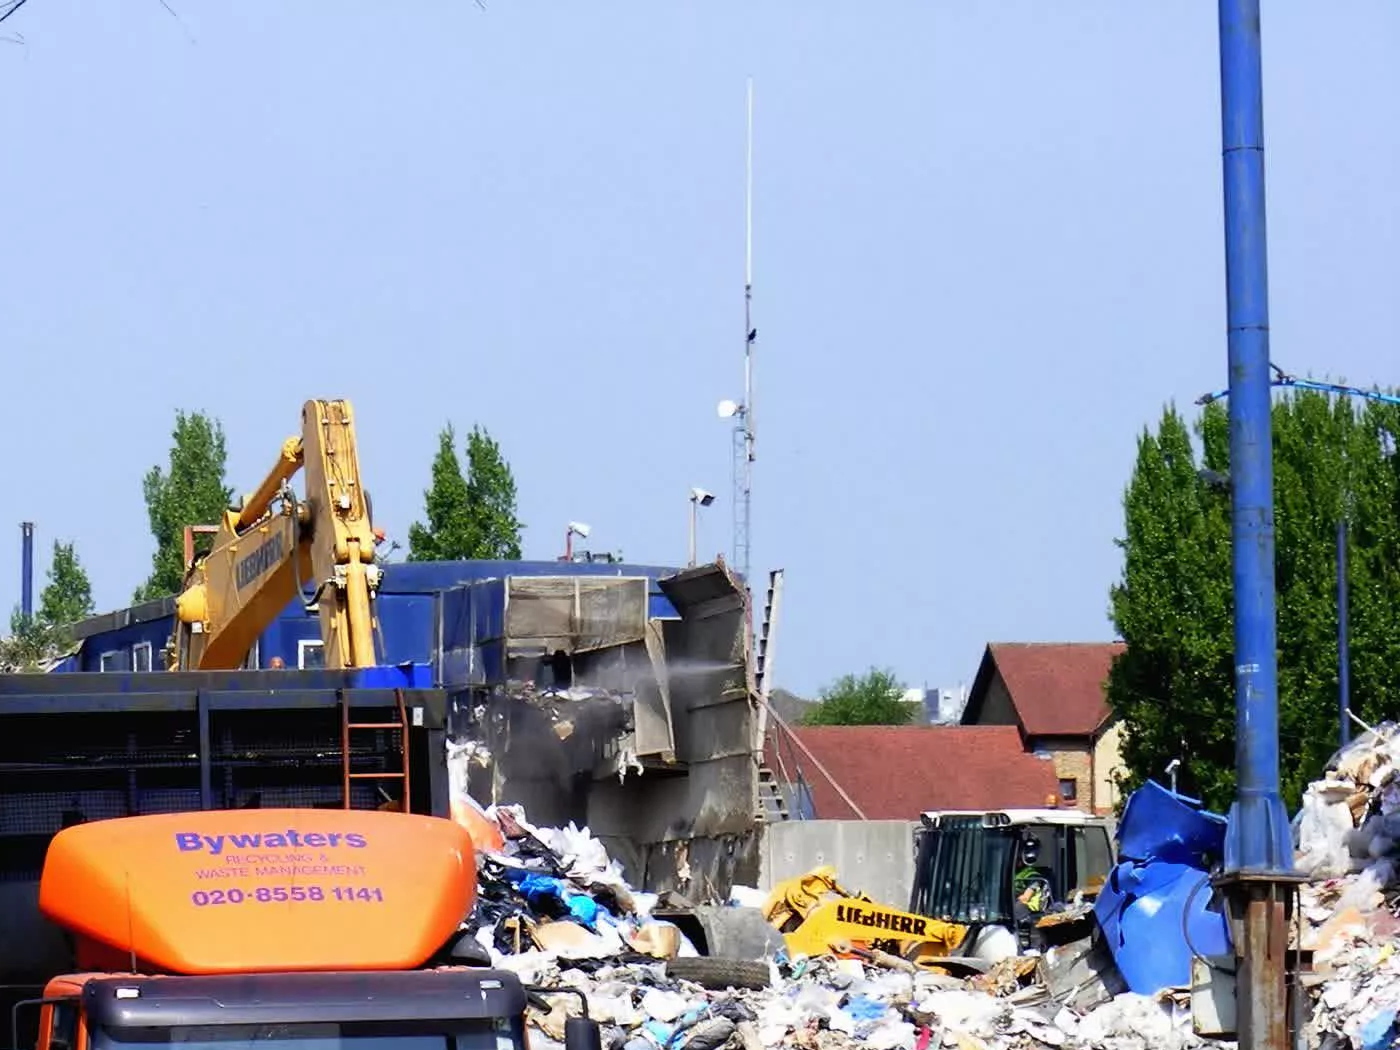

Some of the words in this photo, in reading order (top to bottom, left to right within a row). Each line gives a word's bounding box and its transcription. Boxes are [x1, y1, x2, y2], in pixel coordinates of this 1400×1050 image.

[175, 829, 368, 855] Bywaters
[225, 853, 313, 865] RECYCLING
[319, 852, 329, 863] &
[195, 866, 249, 880] WASTE
[255, 865, 368, 877] MANAGEMENT
[331, 886, 385, 903] 1141
[836, 904, 927, 937] LIEBHERR
